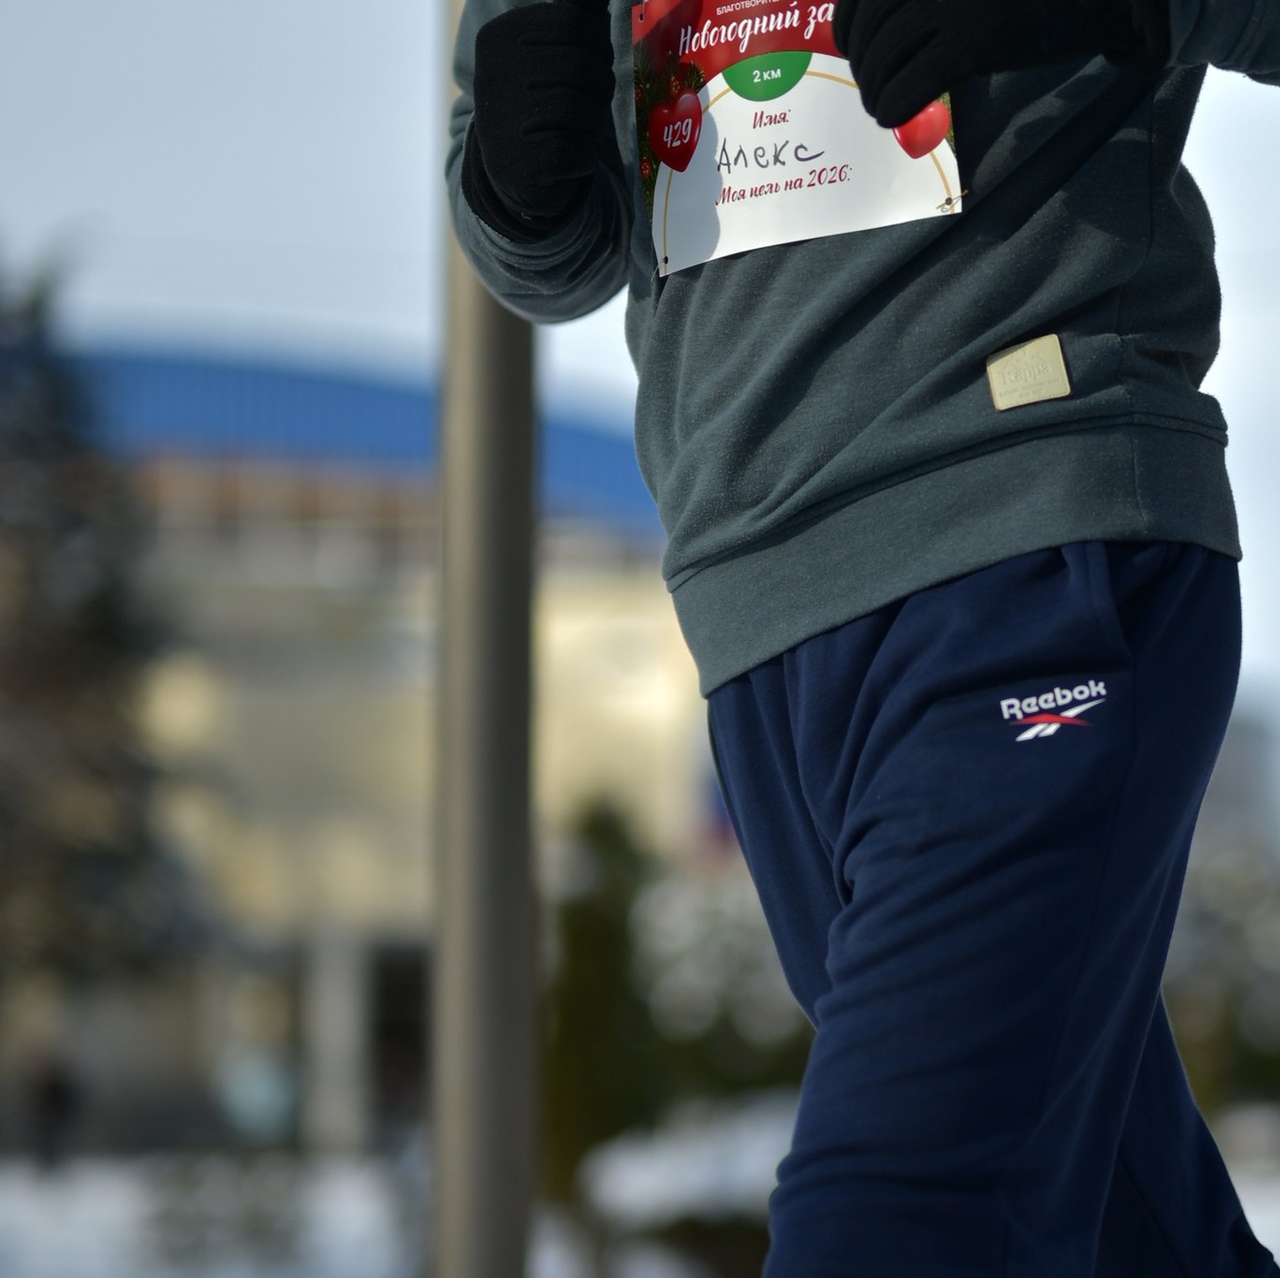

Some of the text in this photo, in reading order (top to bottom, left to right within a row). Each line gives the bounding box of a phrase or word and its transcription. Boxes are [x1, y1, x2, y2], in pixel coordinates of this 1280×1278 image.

[678, 1, 801, 56] Новогодний
[752, 70, 761, 83] 2
[663, 118, 693, 148] 429
[752, 109, 791, 130] Имя:
[715, 164, 853, 206] Моя цель на 2026:
[1000, 680, 1107, 720] Reebok
